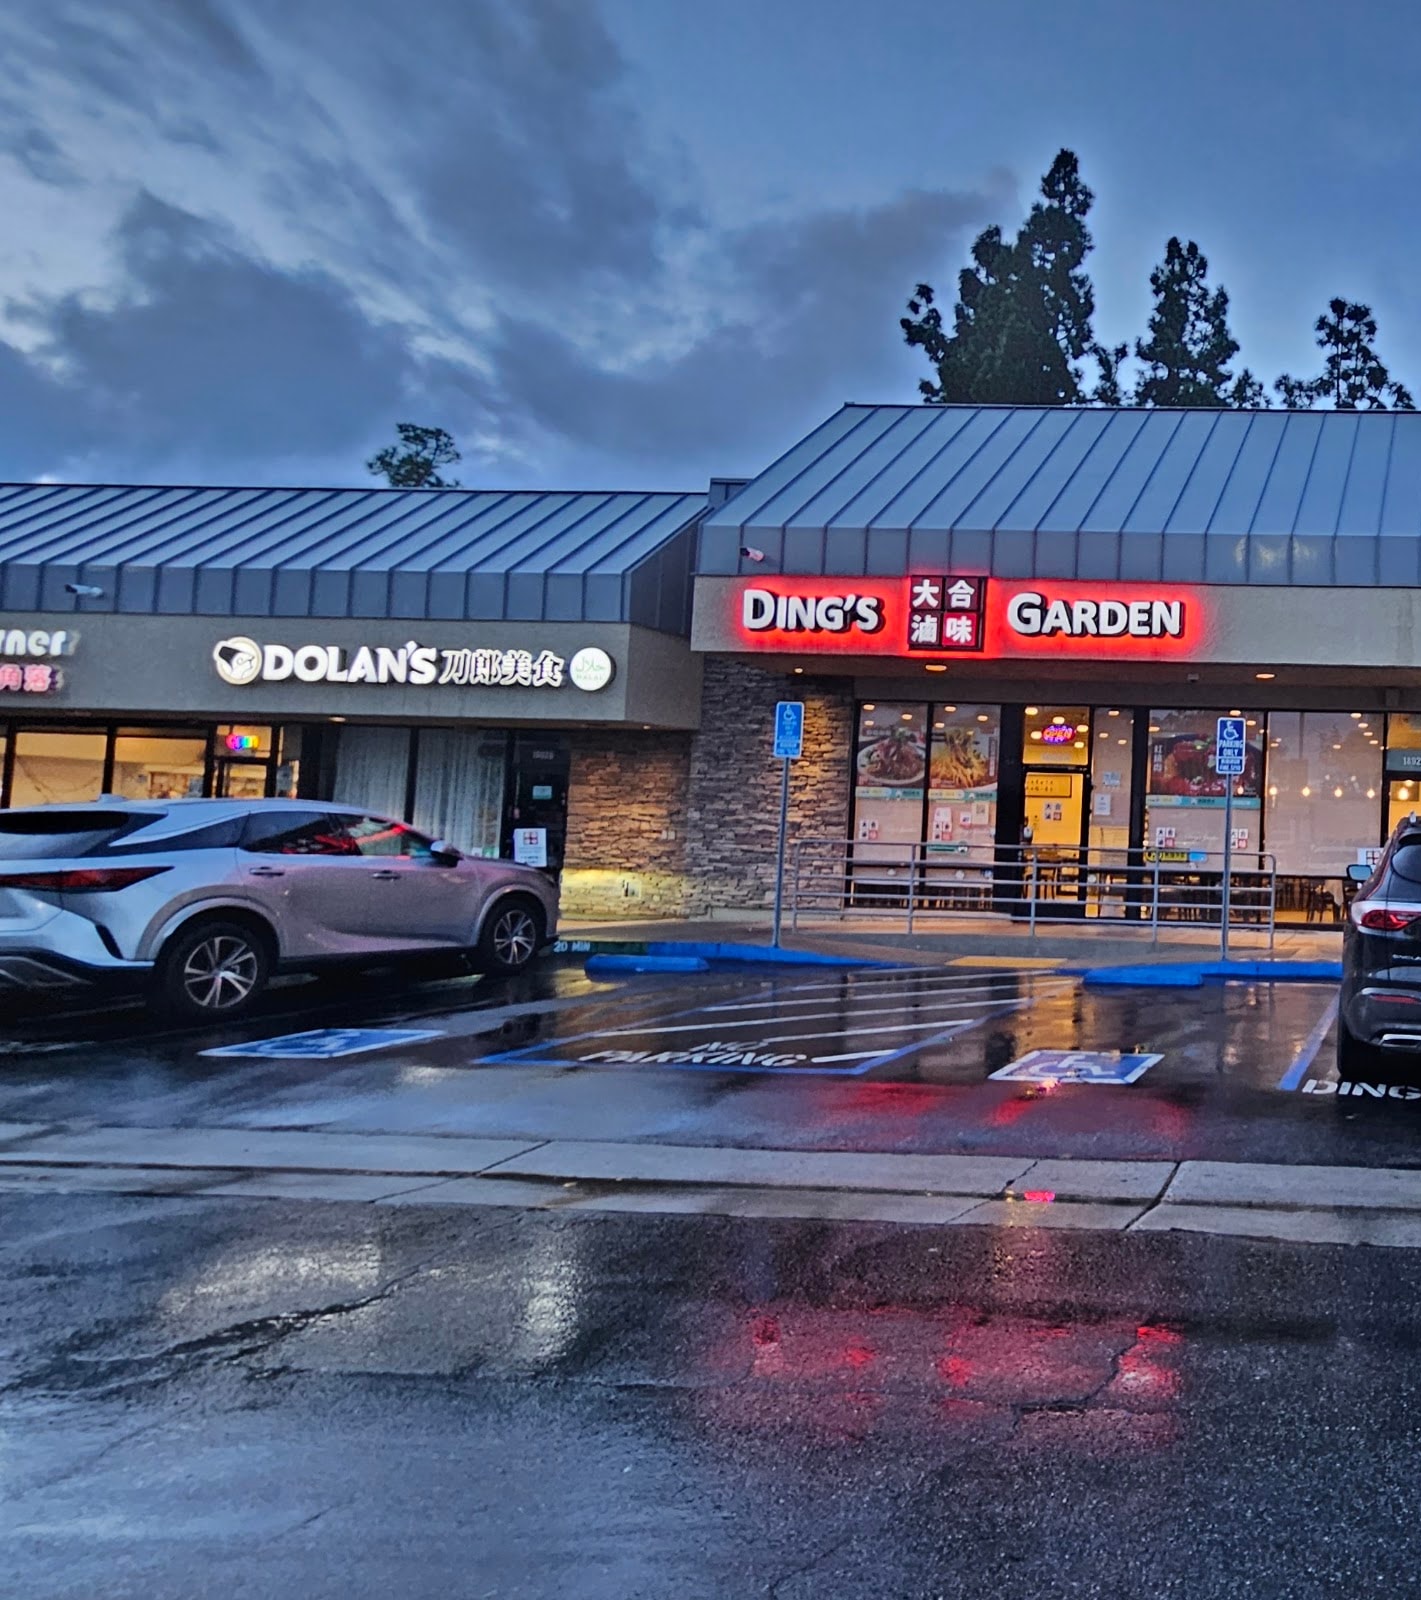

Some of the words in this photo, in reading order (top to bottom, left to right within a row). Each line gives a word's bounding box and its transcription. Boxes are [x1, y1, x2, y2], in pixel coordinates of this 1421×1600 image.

[742, 588, 880, 634] DING'S
[912, 579, 975, 608] 大合
[1006, 592, 1183, 637] GARDEN
[262, 640, 438, 685] DOLAN'S
[553, 941, 568, 951] 20
